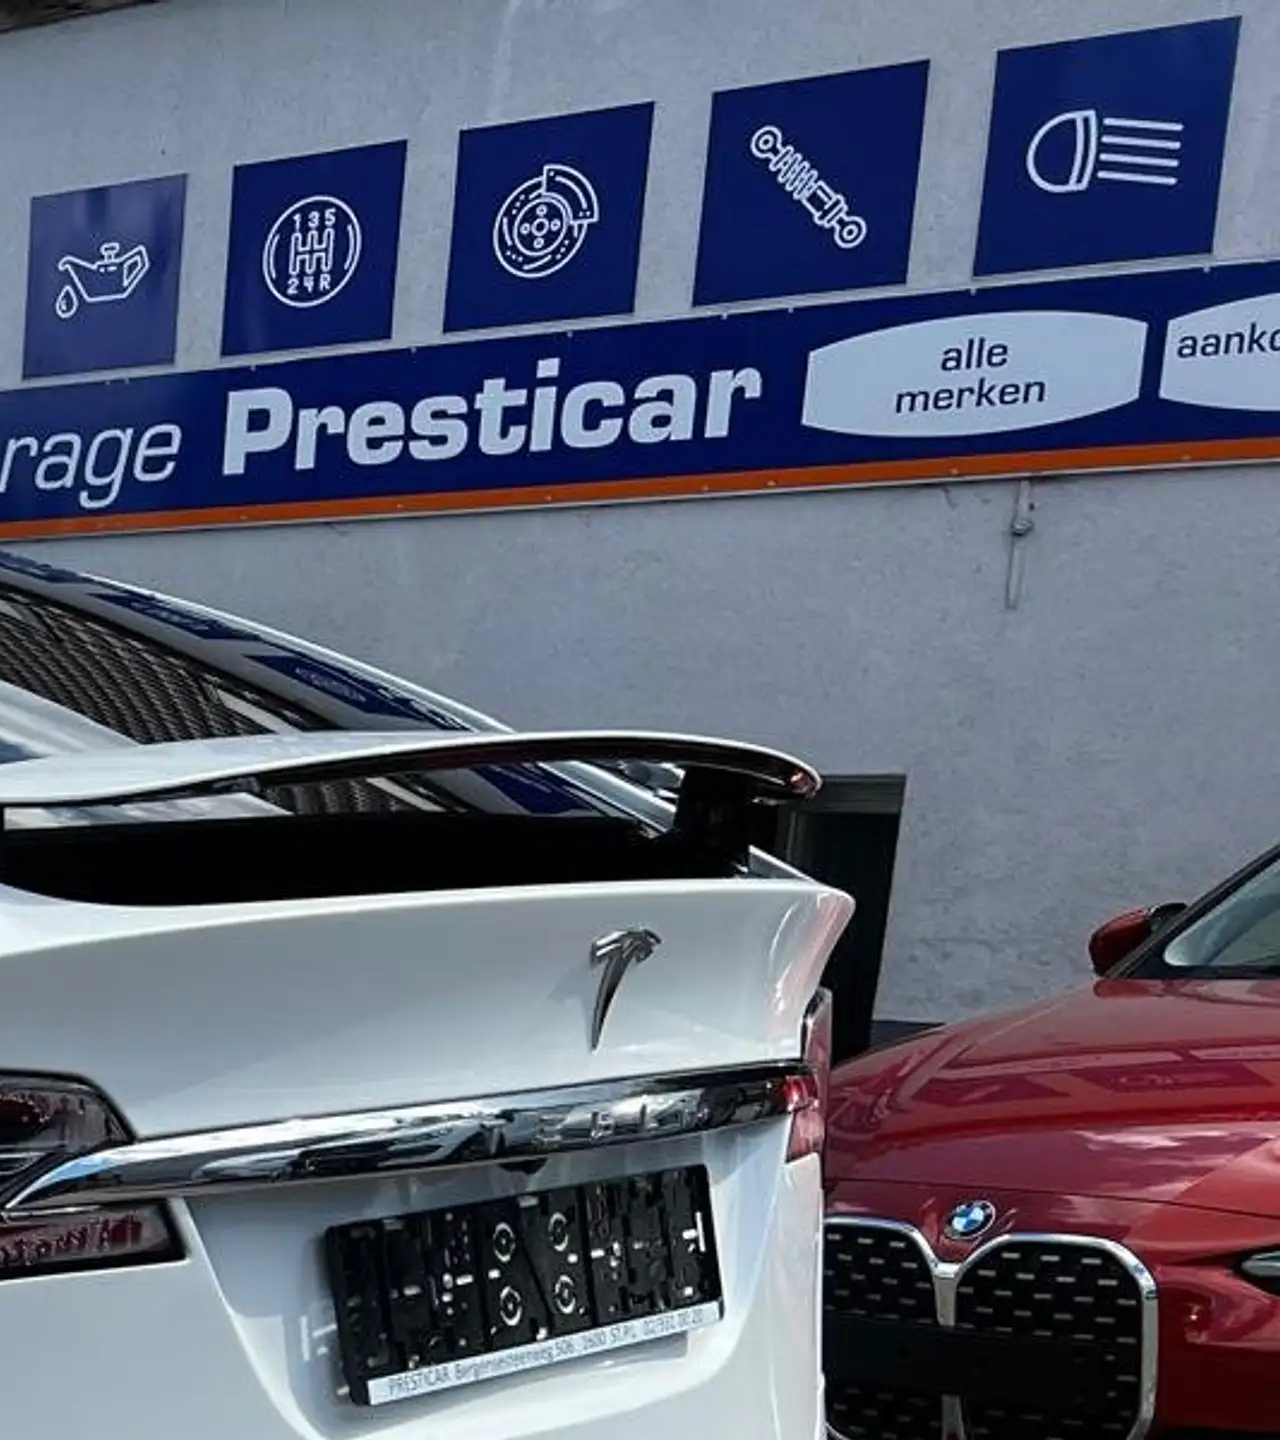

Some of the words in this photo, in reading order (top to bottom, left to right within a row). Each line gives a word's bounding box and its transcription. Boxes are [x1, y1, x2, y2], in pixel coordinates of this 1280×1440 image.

[940, 337, 1009, 372] alle
[895, 377, 1046, 413] merken
[222, 357, 763, 476] Presticar
[387, 1366, 449, 1398] PRESTICAR
